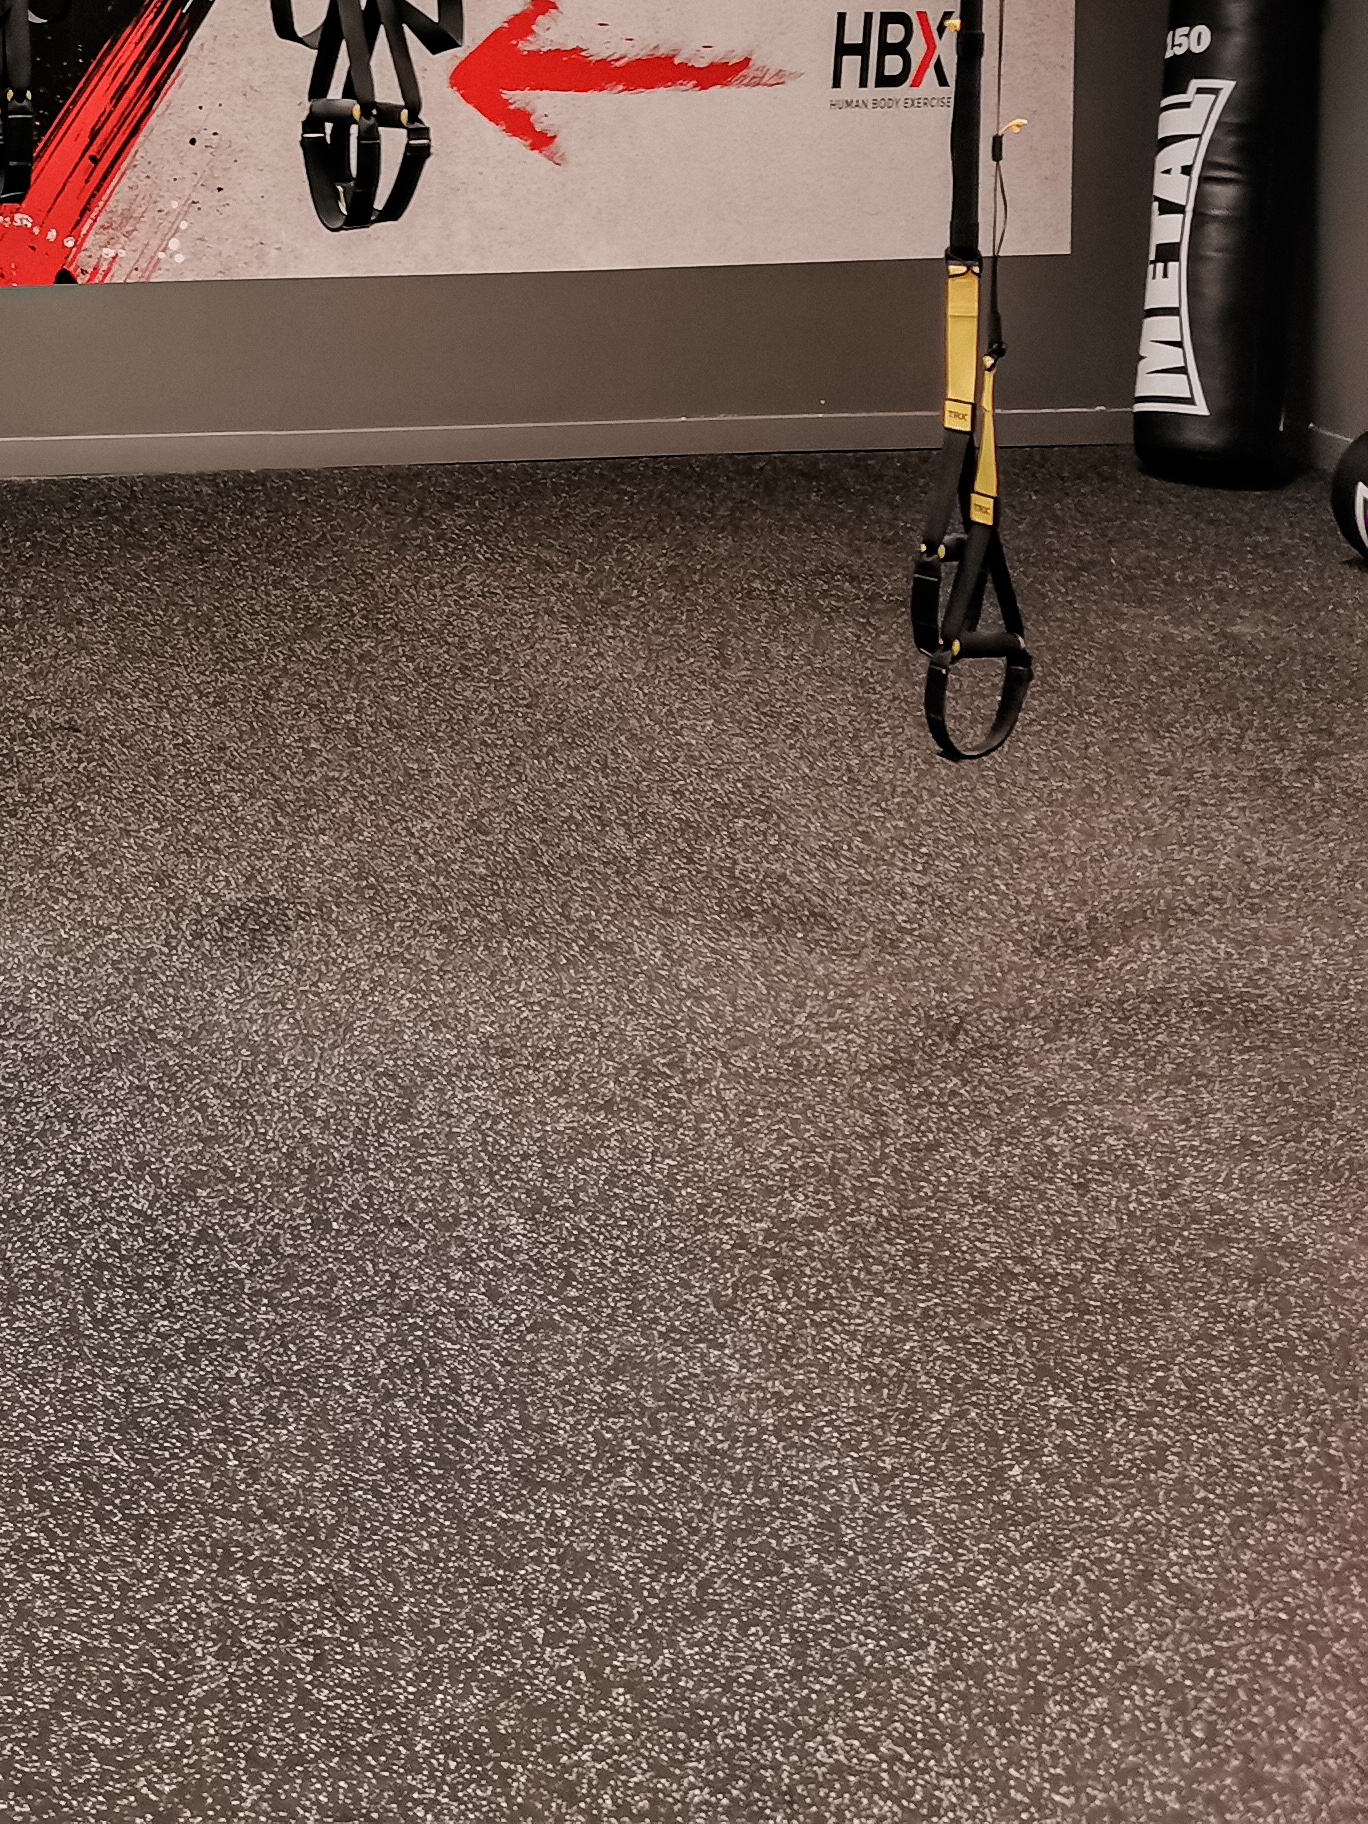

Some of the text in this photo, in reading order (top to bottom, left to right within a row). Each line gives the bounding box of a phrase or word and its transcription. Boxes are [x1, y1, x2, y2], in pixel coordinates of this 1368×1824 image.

[832, 10, 956, 89] HBX
[1164, 24, 1212, 59] 150
[830, 96, 952, 110] HUMAN BODY EXERCISE
[1134, 92, 1218, 398] METAL
[948, 411, 968, 421] TRX
